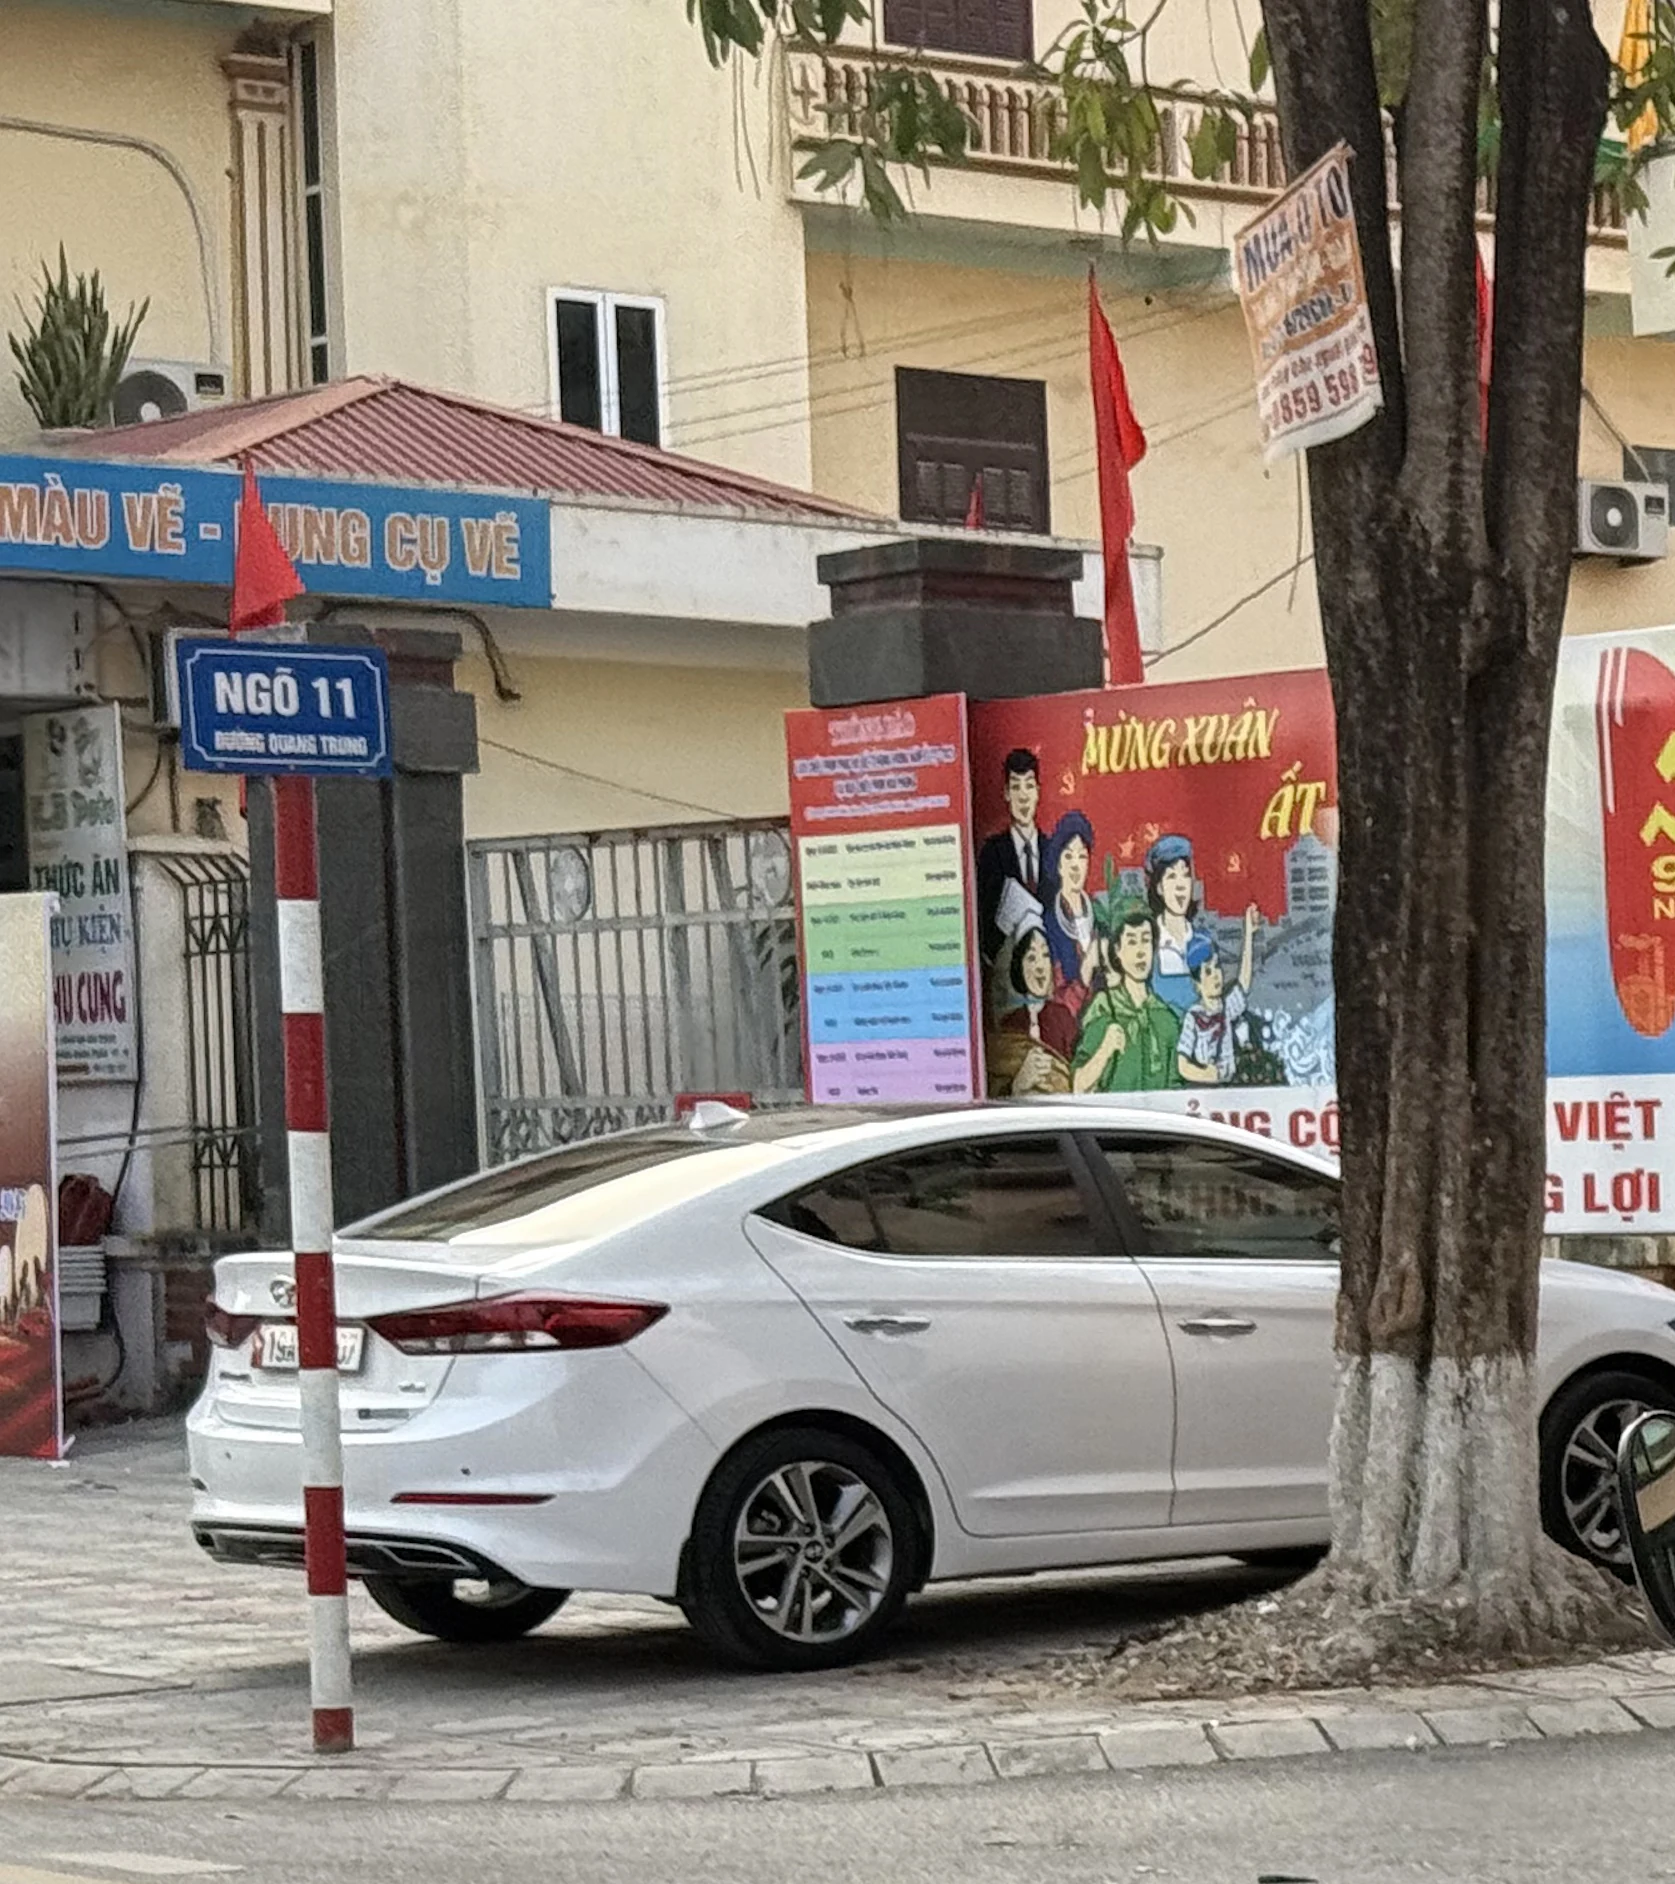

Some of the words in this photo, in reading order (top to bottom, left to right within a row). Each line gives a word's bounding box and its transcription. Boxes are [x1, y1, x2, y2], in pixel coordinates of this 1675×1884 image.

[0, 472, 108, 549] MÀU
[121, 482, 186, 556] VẼ
[234, 498, 373, 570] UNG
[384, 510, 450, 587] CỤ
[462, 510, 521, 581] VẼ
[213, 667, 300, 717] NGÕ
[311, 676, 356, 720] 11
[1081, 707, 1176, 776] MỪNG
[1177, 696, 1280, 767] XUÂN
[1259, 760, 1327, 842] ẤT
[1554, 1092, 1661, 1150] VIỆT
[1583, 1170, 1661, 1221] LỢI
